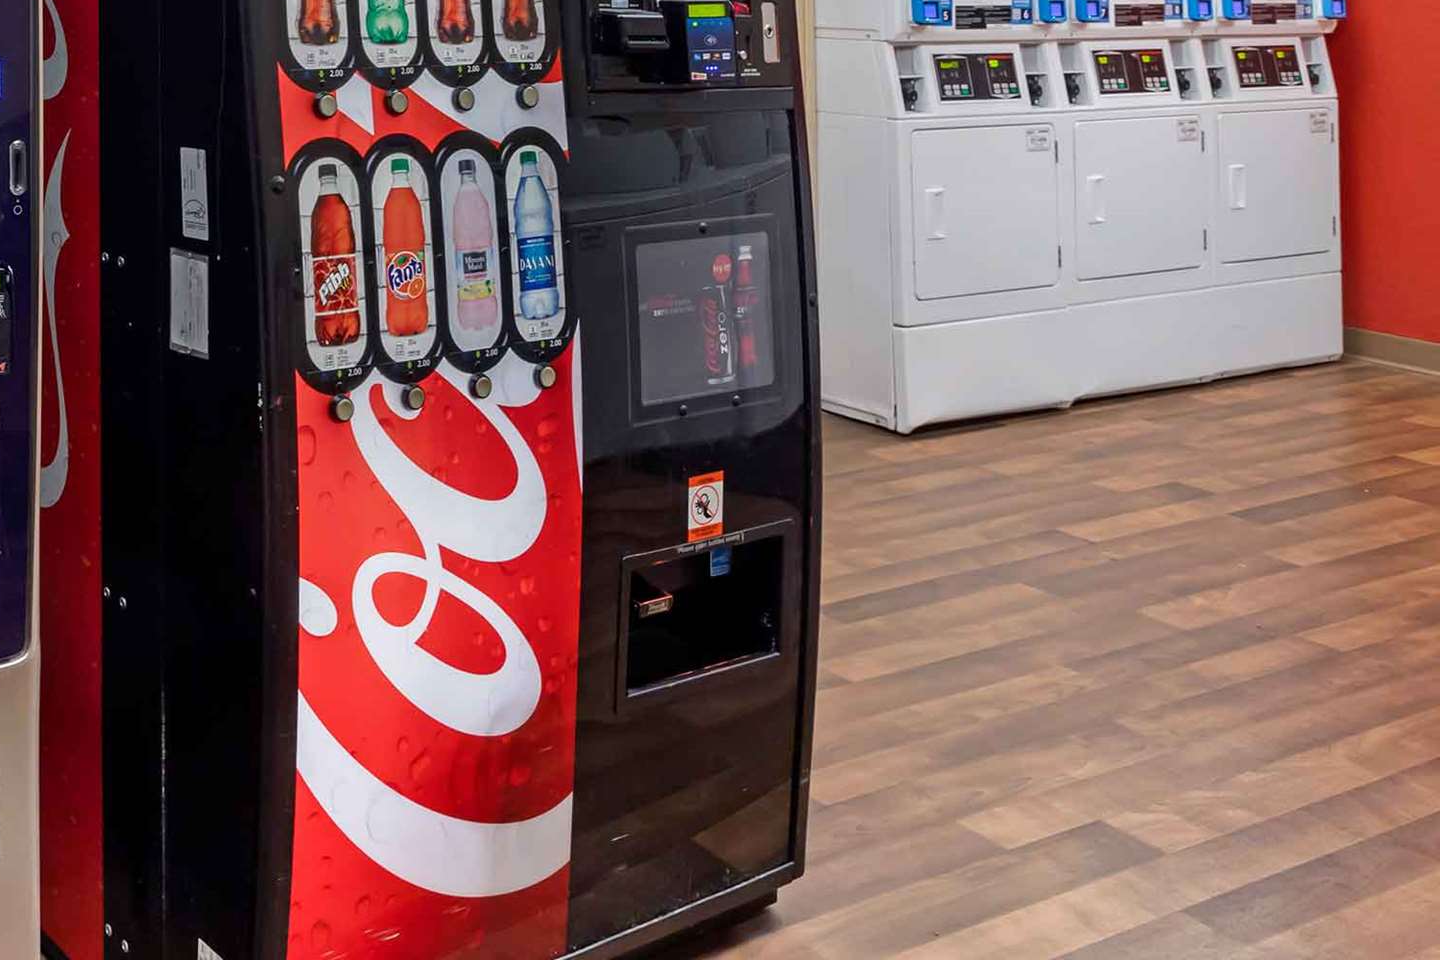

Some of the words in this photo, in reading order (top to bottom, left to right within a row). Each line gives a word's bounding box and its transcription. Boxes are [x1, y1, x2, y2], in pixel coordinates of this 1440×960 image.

[943, 11, 948, 20] 5
[1024, 10, 1029, 19] 6
[401, 66, 414, 75] 2.00
[467, 64, 480, 73] 2.00
[529, 62, 542, 70] 2.00
[330, 69, 344, 78] 2.00
[519, 255, 555, 272] DASANI
[388, 259, 423, 290] Fanta
[718, 311, 728, 354] zero
[549, 339, 561, 347] 2.00
[485, 348, 498, 356] 2.00
[416, 359, 430, 367] 2.00
[348, 368, 362, 376] 2.00
